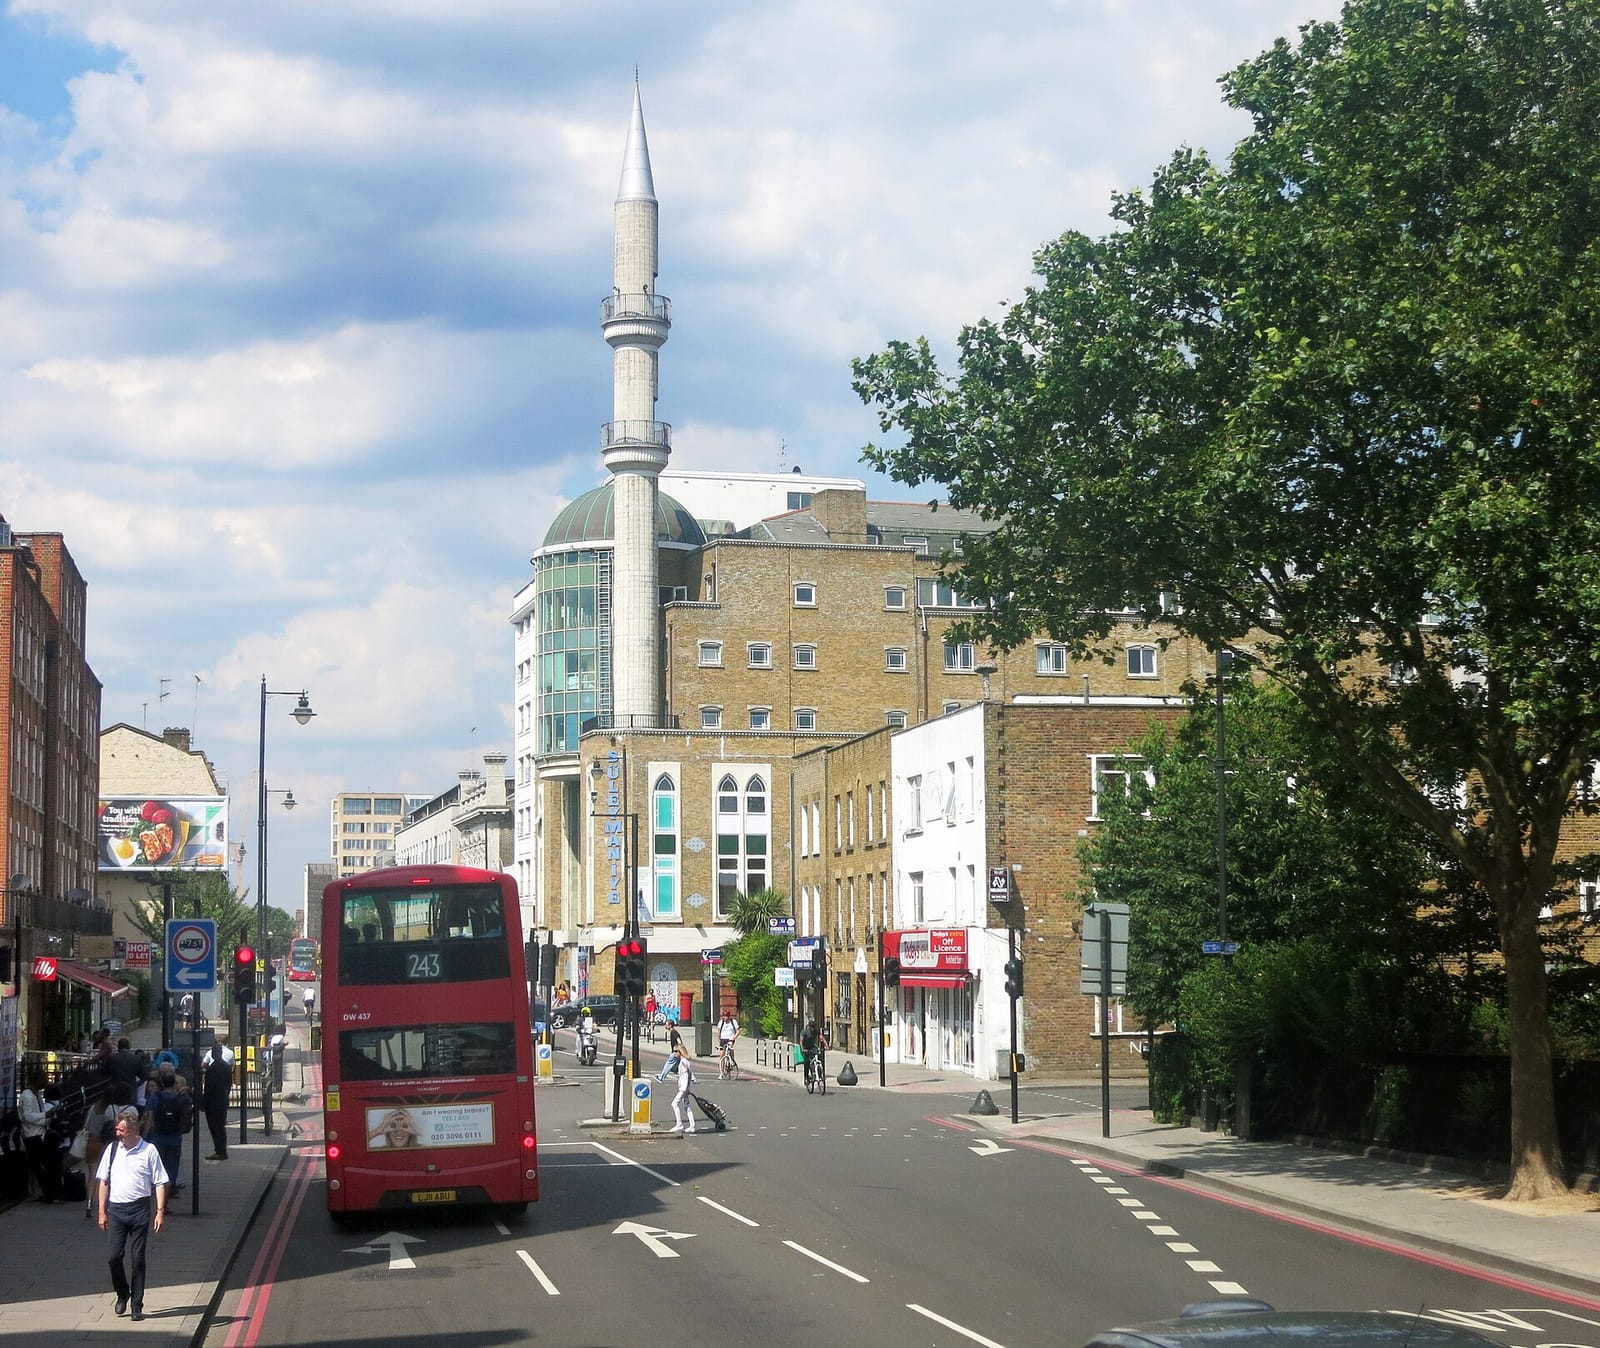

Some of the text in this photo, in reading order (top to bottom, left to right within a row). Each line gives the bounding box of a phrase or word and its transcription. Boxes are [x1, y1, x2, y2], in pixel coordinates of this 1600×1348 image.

[108, 805, 143, 817] Toy with
[34, 960, 55, 979] illy
[408, 953, 440, 977] 243
[438, 1108, 463, 1116] wearing
[464, 1106, 489, 1114] braces?
[465, 1131, 482, 1139] 0111
